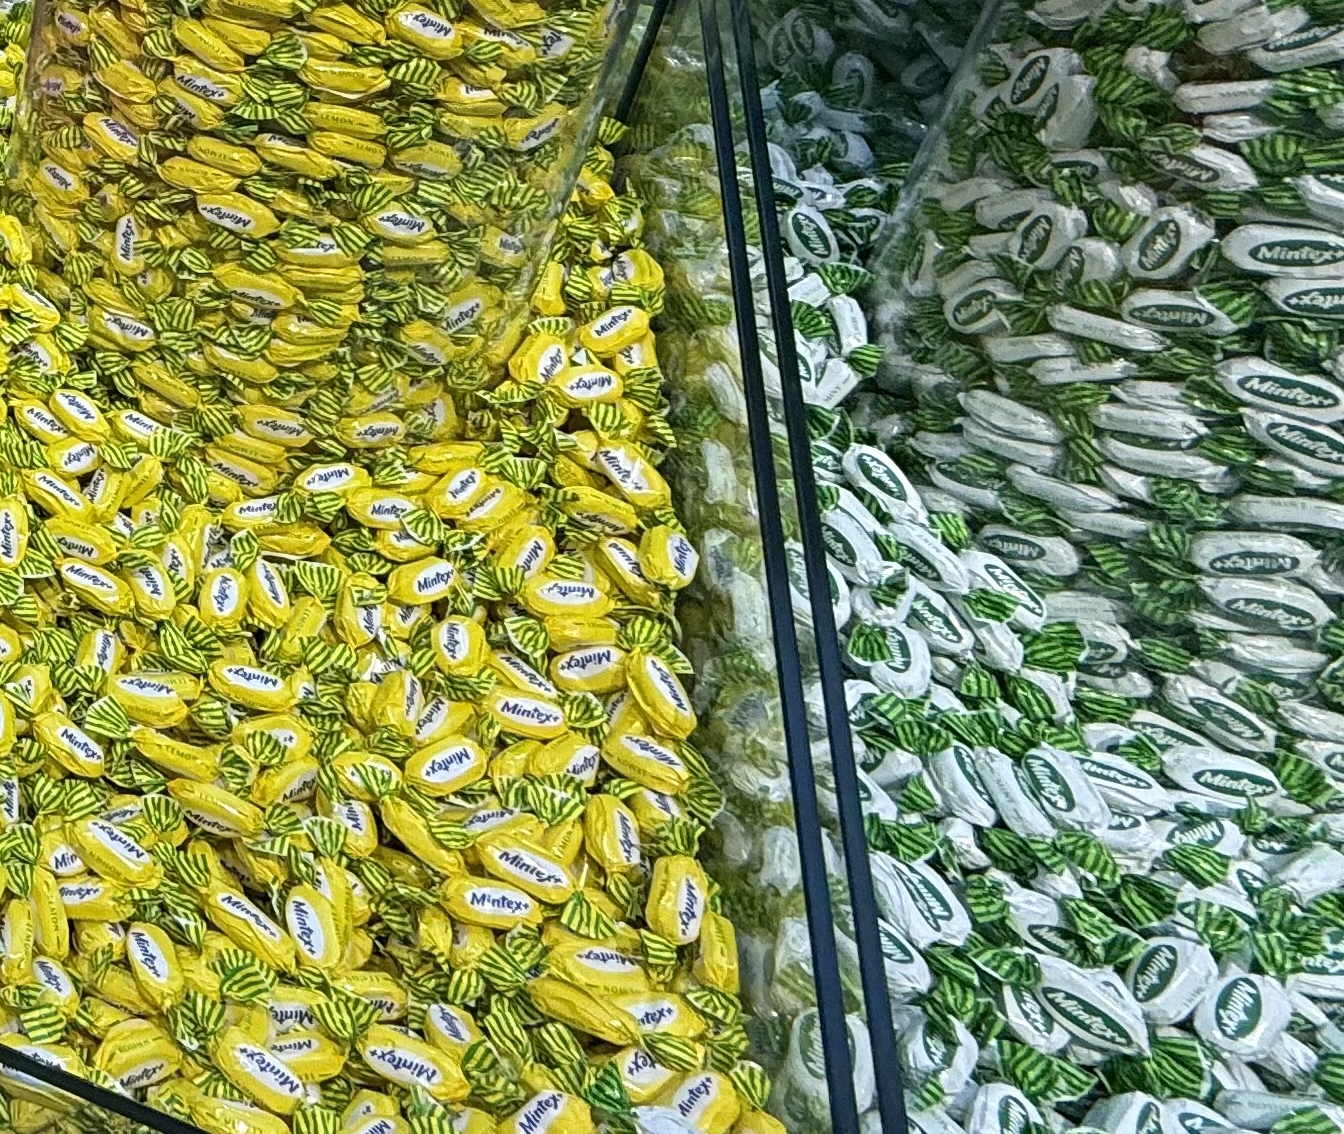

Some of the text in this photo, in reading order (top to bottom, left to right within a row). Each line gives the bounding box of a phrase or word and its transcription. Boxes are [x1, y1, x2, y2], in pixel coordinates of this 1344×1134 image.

[571, 376, 611, 390] Mintex+
[1246, 377, 1334, 406] Mintex+
[3, 512, 13, 559] Mintex+
[418, 569, 454, 593] Mintex+
[561, 650, 611, 671] Mintex+
[501, 702, 559, 723] Mintex+
[62, 730, 101, 760] Mintex+
[425, 748, 471, 778] Mintex+
[1201, 771, 1274, 796] Mintex+
[92, 821, 145, 859] Mintex+
[499, 852, 563, 884] Mintex+
[471, 892, 530, 913] Mintex+
[679, 879, 695, 937] Mintex+
[292, 900, 316, 957] Mintex+
[131, 930, 162, 980] Mintex+
[1051, 992, 1124, 1044] Mintex+
[239, 1047, 299, 1093] Mintex+
[369, 1048, 437, 1082] Mintex+
